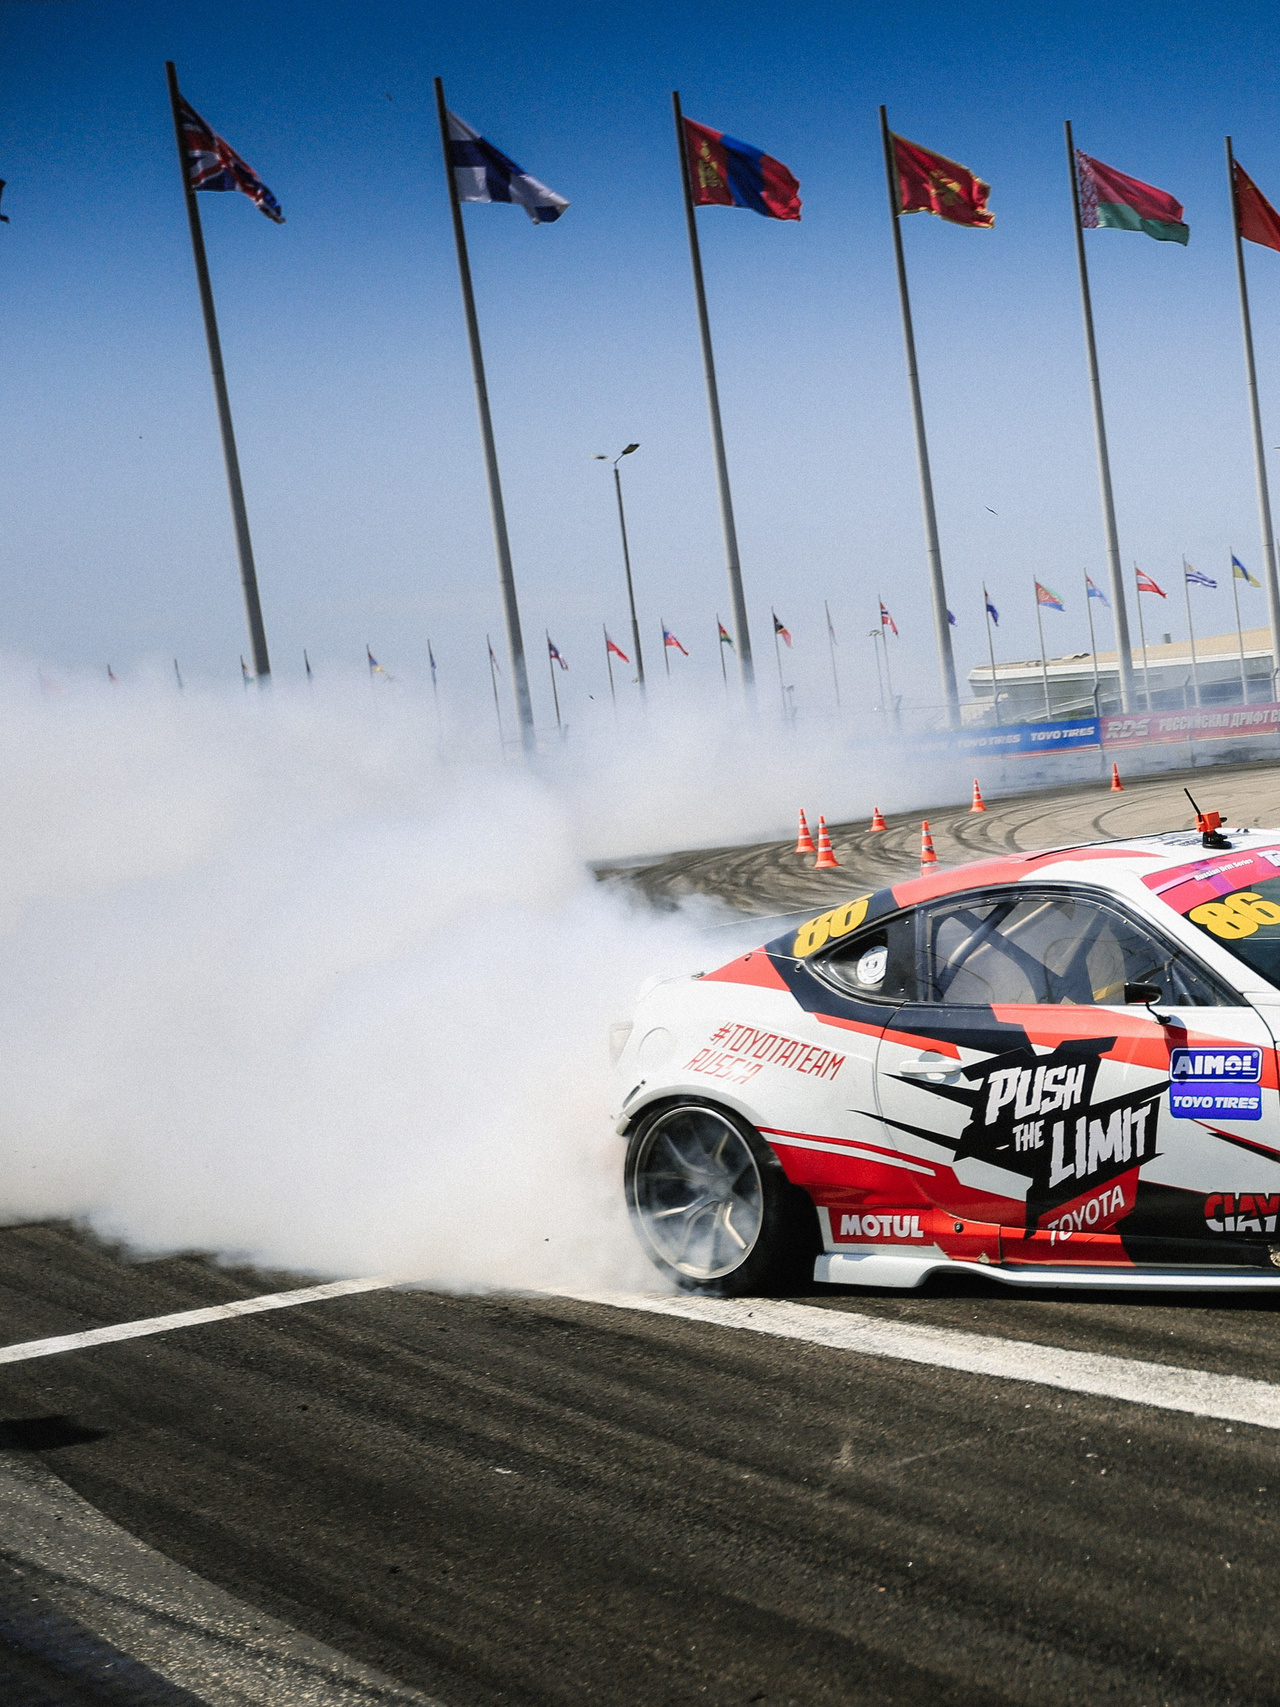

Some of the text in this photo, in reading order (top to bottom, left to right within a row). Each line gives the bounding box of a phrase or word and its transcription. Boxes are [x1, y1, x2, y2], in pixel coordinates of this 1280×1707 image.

[1106, 718, 1152, 739] RDS
[1230, 710, 1271, 728] ДРИФТ
[1030, 726, 1095, 742] TOYO TIRES
[793, 893, 874, 958] 86
[712, 1021, 847, 1081] #TOYOTATEAM
[1173, 1055, 1257, 1075] AIMOL
[985, 1063, 1087, 1126] PUSH
[1173, 1095, 1260, 1110] TOYO TIRES
[1012, 1119, 1045, 1152] THE
[1048, 1099, 1152, 1189] LIMIT
[840, 1214, 924, 1239] MOTUL
[1047, 1184, 1126, 1246] TOYOTA
